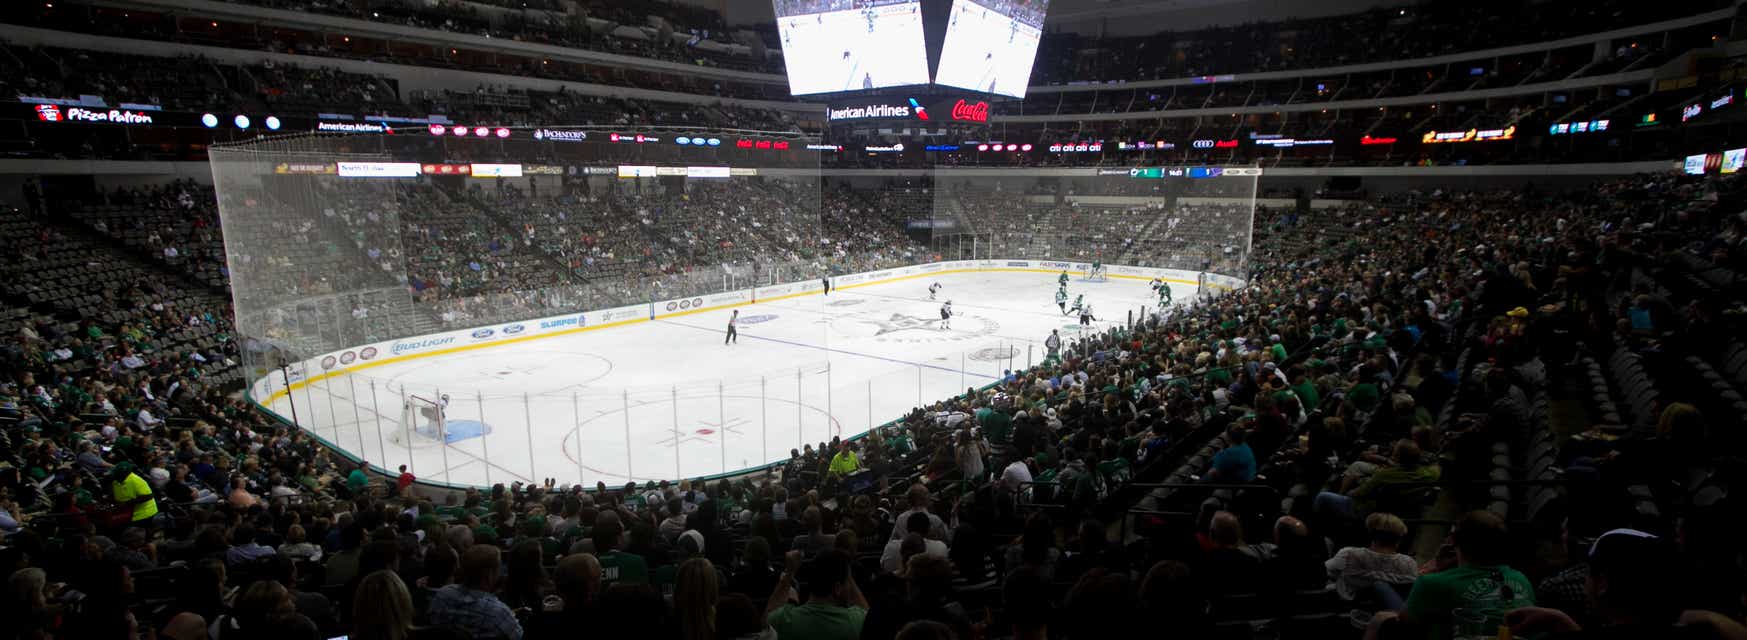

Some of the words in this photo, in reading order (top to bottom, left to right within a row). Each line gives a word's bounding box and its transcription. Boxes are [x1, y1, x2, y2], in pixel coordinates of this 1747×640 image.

[67, 108, 108, 121] Pizza
[830, 106, 865, 120] American
[865, 104, 910, 118] Airlines
[318, 122, 355, 132] American
[355, 123, 384, 133] Airlines
[1216, 140, 1238, 148] Audi
[600, 567, 619, 580] ENN
